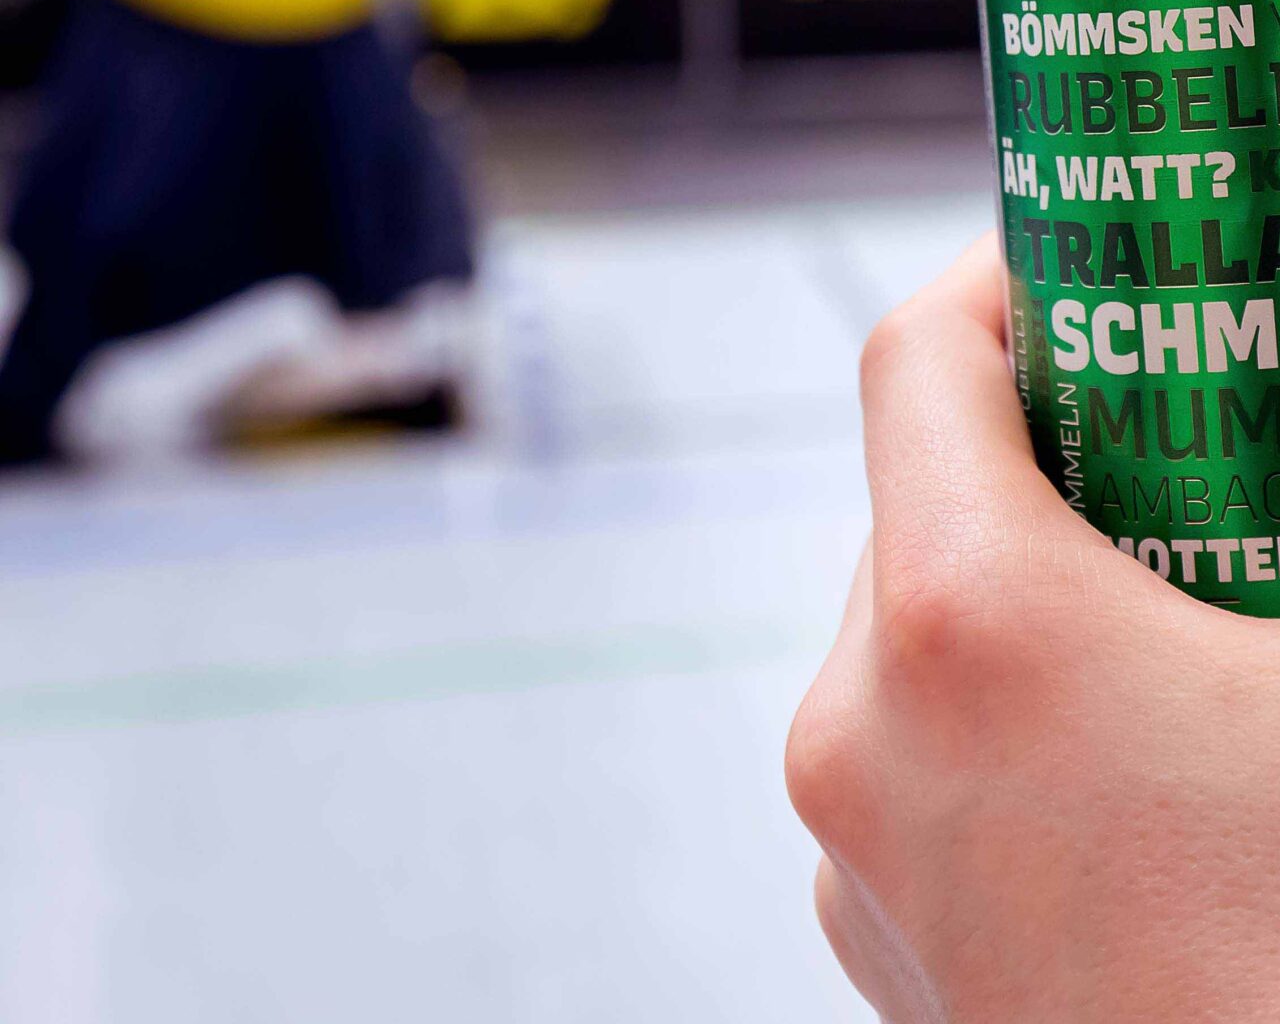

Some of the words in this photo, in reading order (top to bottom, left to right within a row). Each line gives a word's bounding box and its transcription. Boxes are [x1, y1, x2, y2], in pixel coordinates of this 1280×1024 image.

[1003, 1, 1256, 57] BÖMMSKEN
[1002, 137, 1050, 211] ÄH,
[1055, 149, 1237, 203] WATT?
